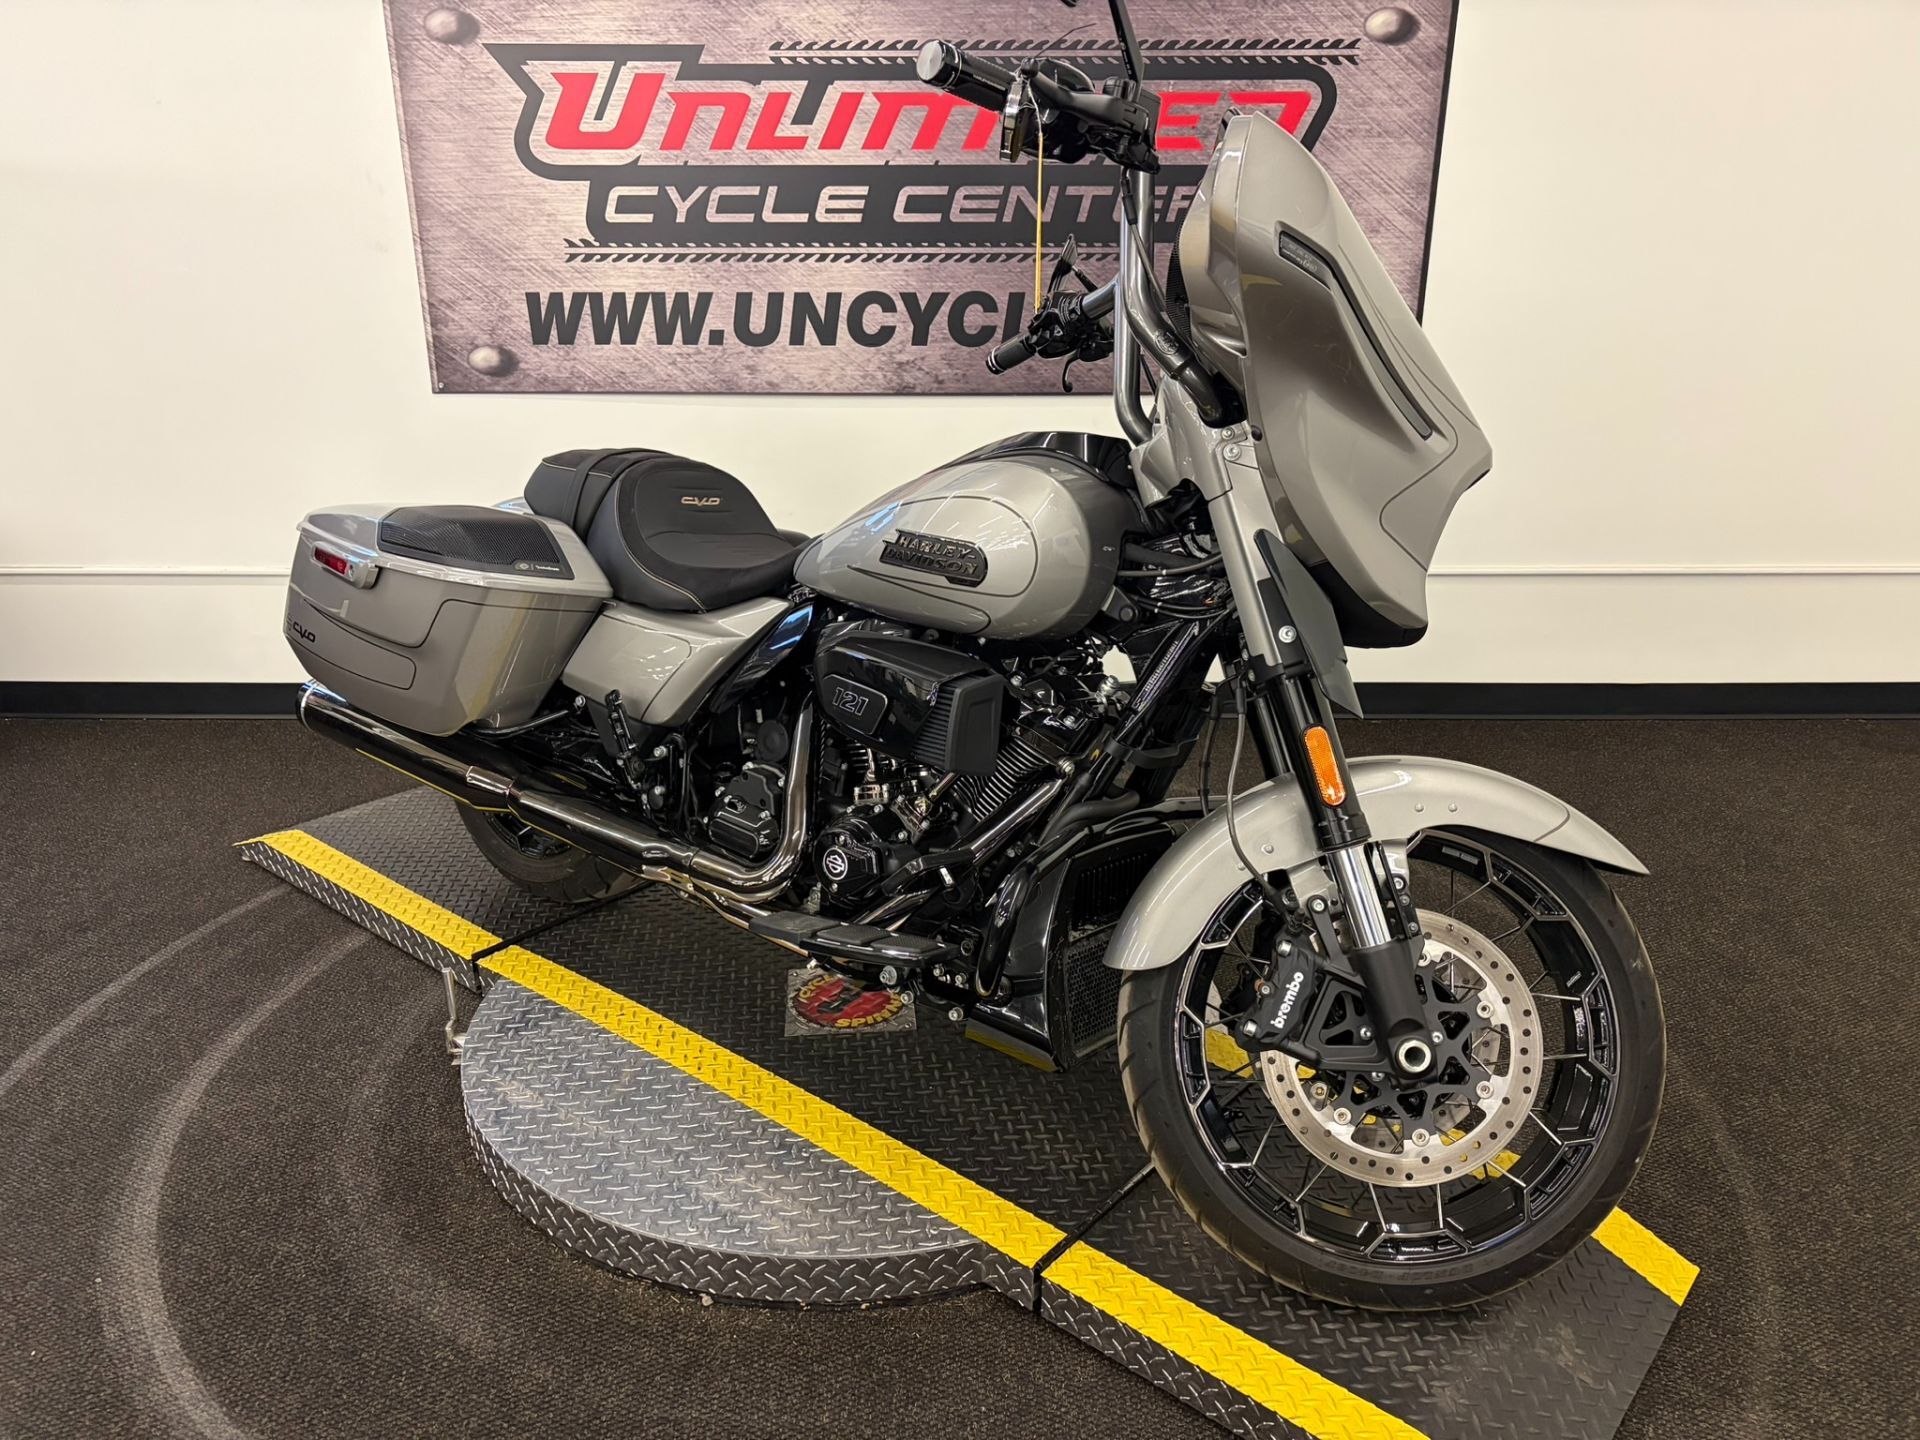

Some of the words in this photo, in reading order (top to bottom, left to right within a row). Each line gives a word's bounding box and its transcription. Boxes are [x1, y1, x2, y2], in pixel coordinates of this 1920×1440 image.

[605, 186, 870, 223] CYCLE
[680, 496, 721, 507] CVO
[292, 621, 316, 643] CVO
[832, 686, 869, 716] 121
[1270, 971, 1305, 1029] brembo
